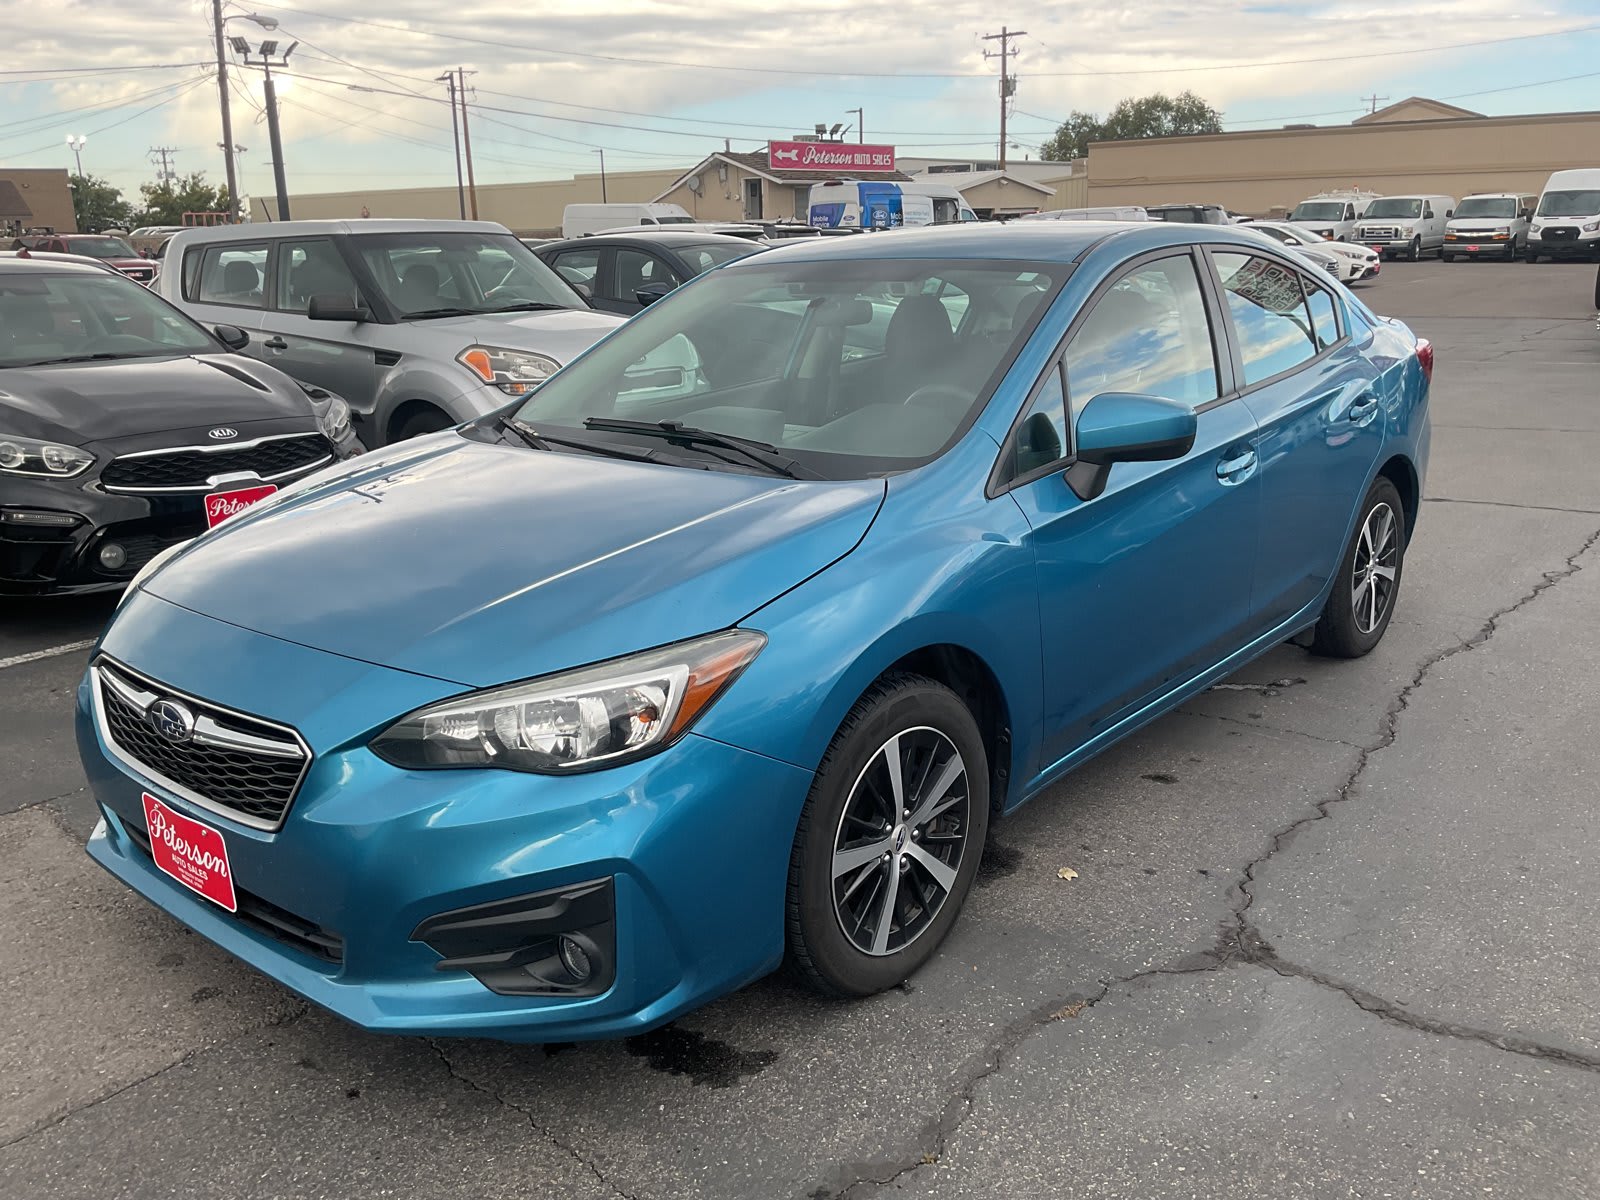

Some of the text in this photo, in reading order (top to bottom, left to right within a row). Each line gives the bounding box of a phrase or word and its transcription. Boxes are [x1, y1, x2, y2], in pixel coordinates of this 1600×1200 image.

[803, 146, 891, 166] Peterson AUTO SALES
[212, 428, 235, 437] KIA
[150, 809, 227, 877] Peterson
[171, 853, 187, 869] AUTO
[187, 862, 208, 880] SALES
